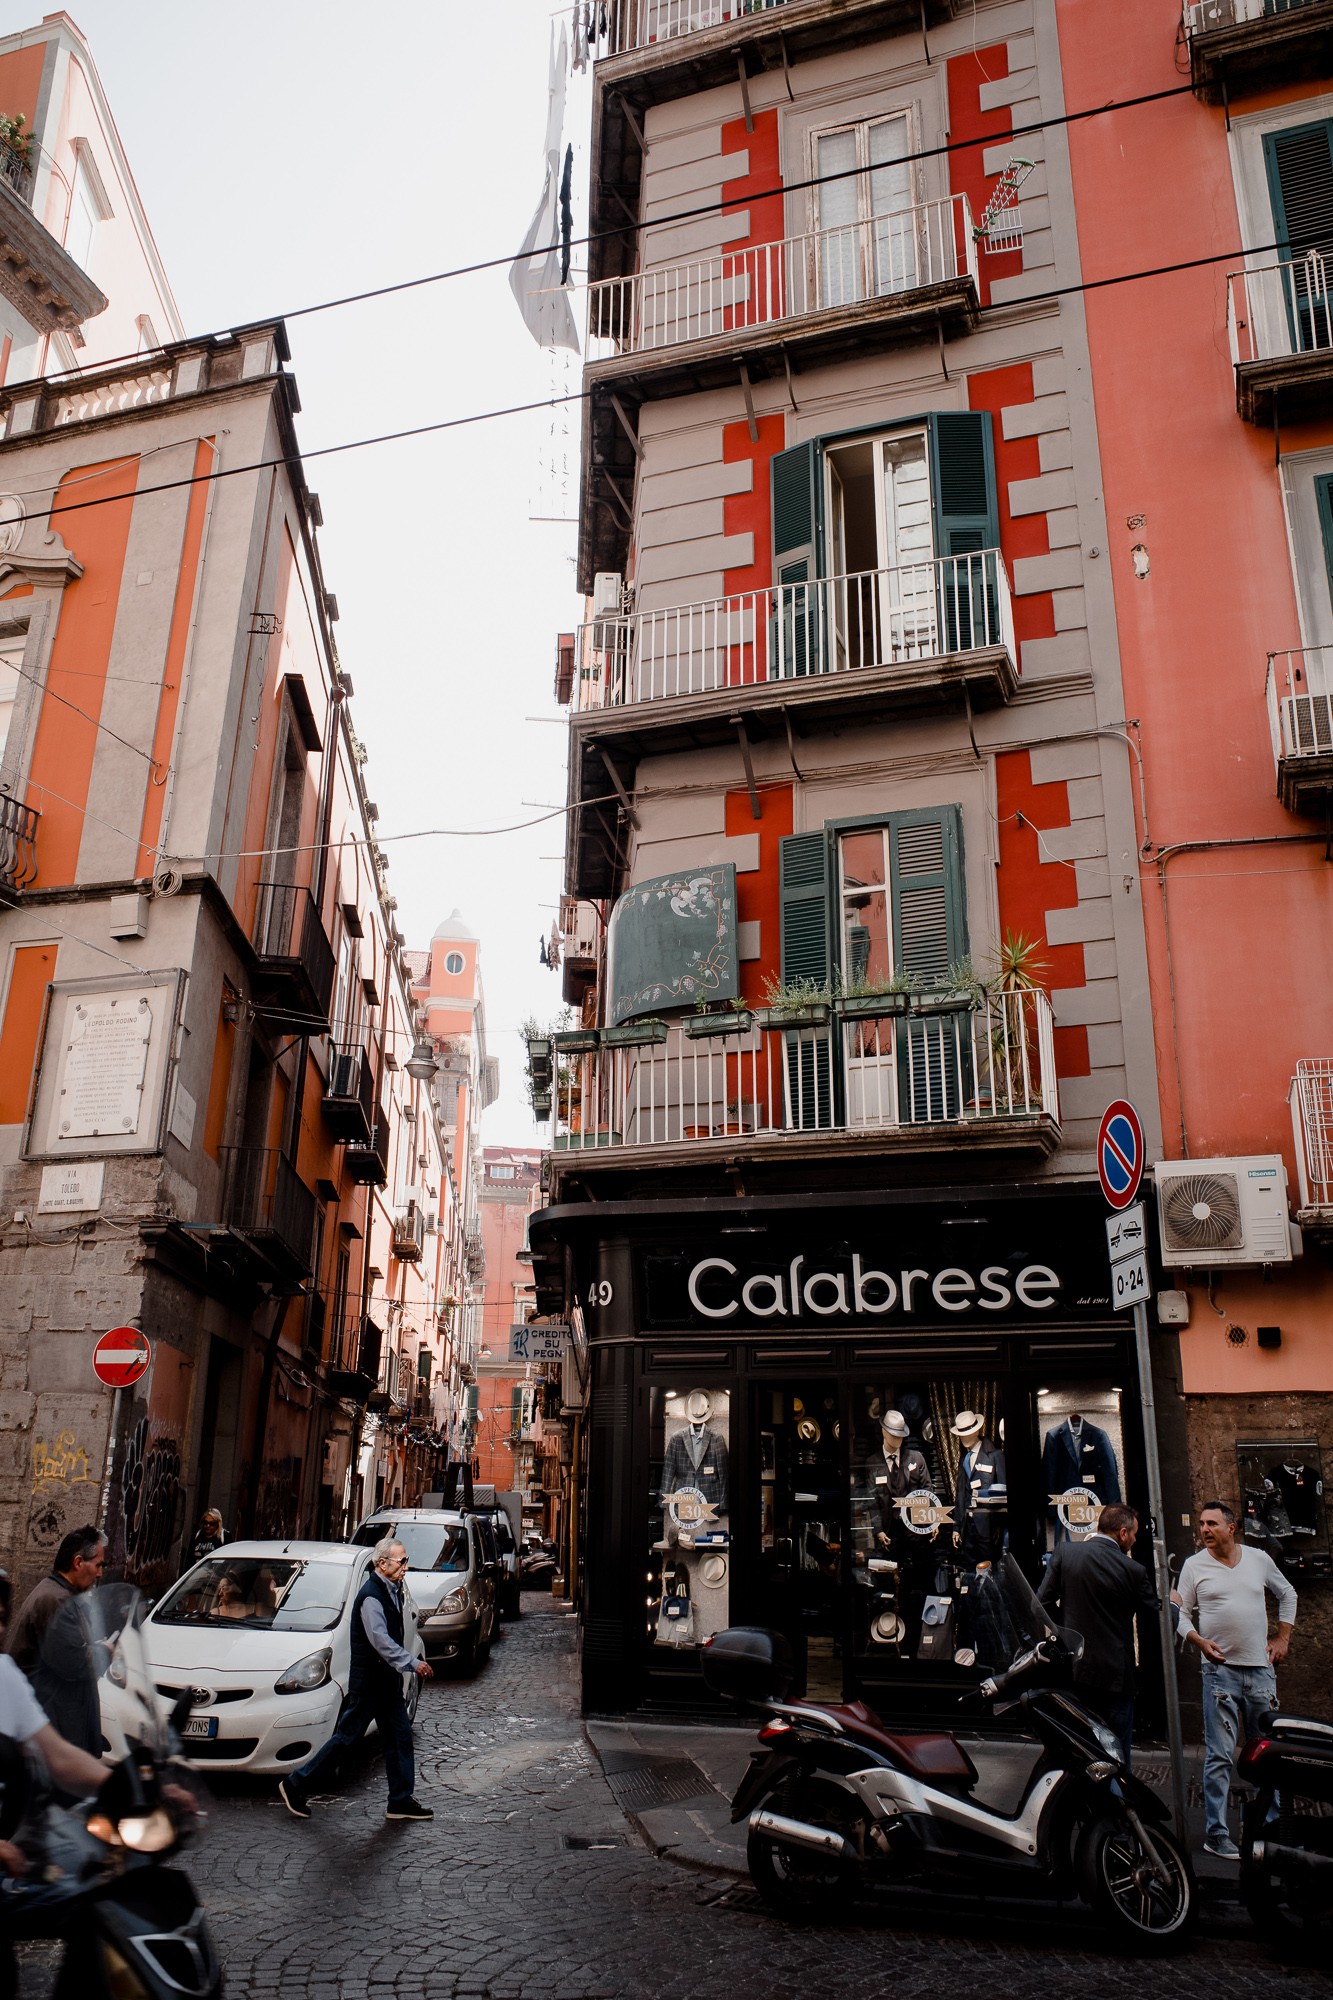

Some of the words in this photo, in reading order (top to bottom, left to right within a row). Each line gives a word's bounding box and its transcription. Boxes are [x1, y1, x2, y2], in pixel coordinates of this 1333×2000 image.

[84, 1019, 114, 1028] LEOPOLDO
[67, 1170, 77, 1178] VIA
[1248, 1170, 1276, 1178] Hisense
[61, 1183, 81, 1194] TOLEDO
[688, 1254, 1060, 1318] Calabrese
[588, 1280, 613, 1307] 49
[1076, 1297, 1092, 1305] dal
[544, 1339, 560, 1348] SU
[533, 1349, 565, 1358] PEGN
[912, 1490, 938, 1502] SPECIAL
[1069, 1488, 1097, 1500] SPECIAL
[680, 1504, 708, 1518] -30%
[913, 1508, 944, 1523] -30%
[905, 1519, 933, 1534] SUMMER
[1062, 1517, 1093, 1533] SUMMER
